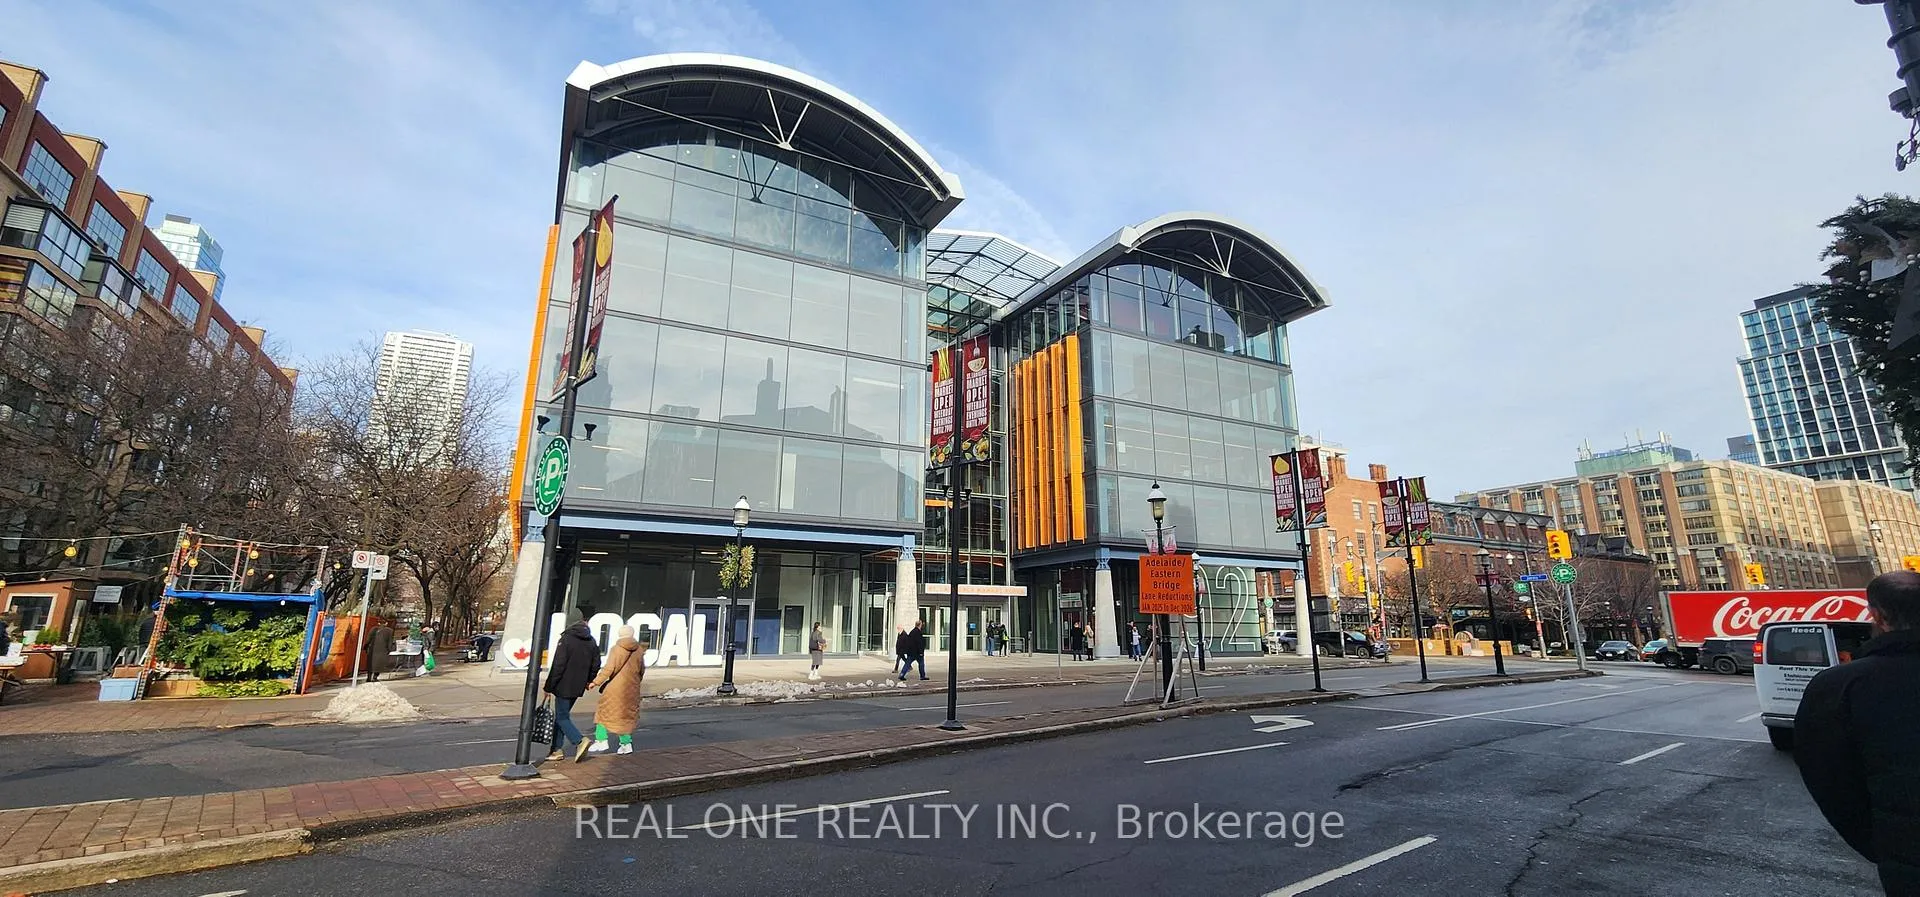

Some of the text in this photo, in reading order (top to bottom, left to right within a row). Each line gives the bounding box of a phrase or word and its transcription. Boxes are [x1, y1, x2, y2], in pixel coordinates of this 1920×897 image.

[967, 375, 987, 389] MARKET
[967, 385, 987, 402] OPEN
[934, 394, 953, 410] OPEN
[544, 457, 561, 488] P
[1276, 484, 1293, 493] OPEN
[1305, 488, 1323, 498] OPEN
[1385, 514, 1401, 522] OPEN
[1411, 511, 1428, 519] OPEN
[1146, 558, 1186, 568] Adelaide/
[1151, 570, 1181, 578] Eastern
[1559, 568, 1569, 577] P
[1153, 581, 1181, 591] Bridge
[1157, 592, 1193, 601] Reductions
